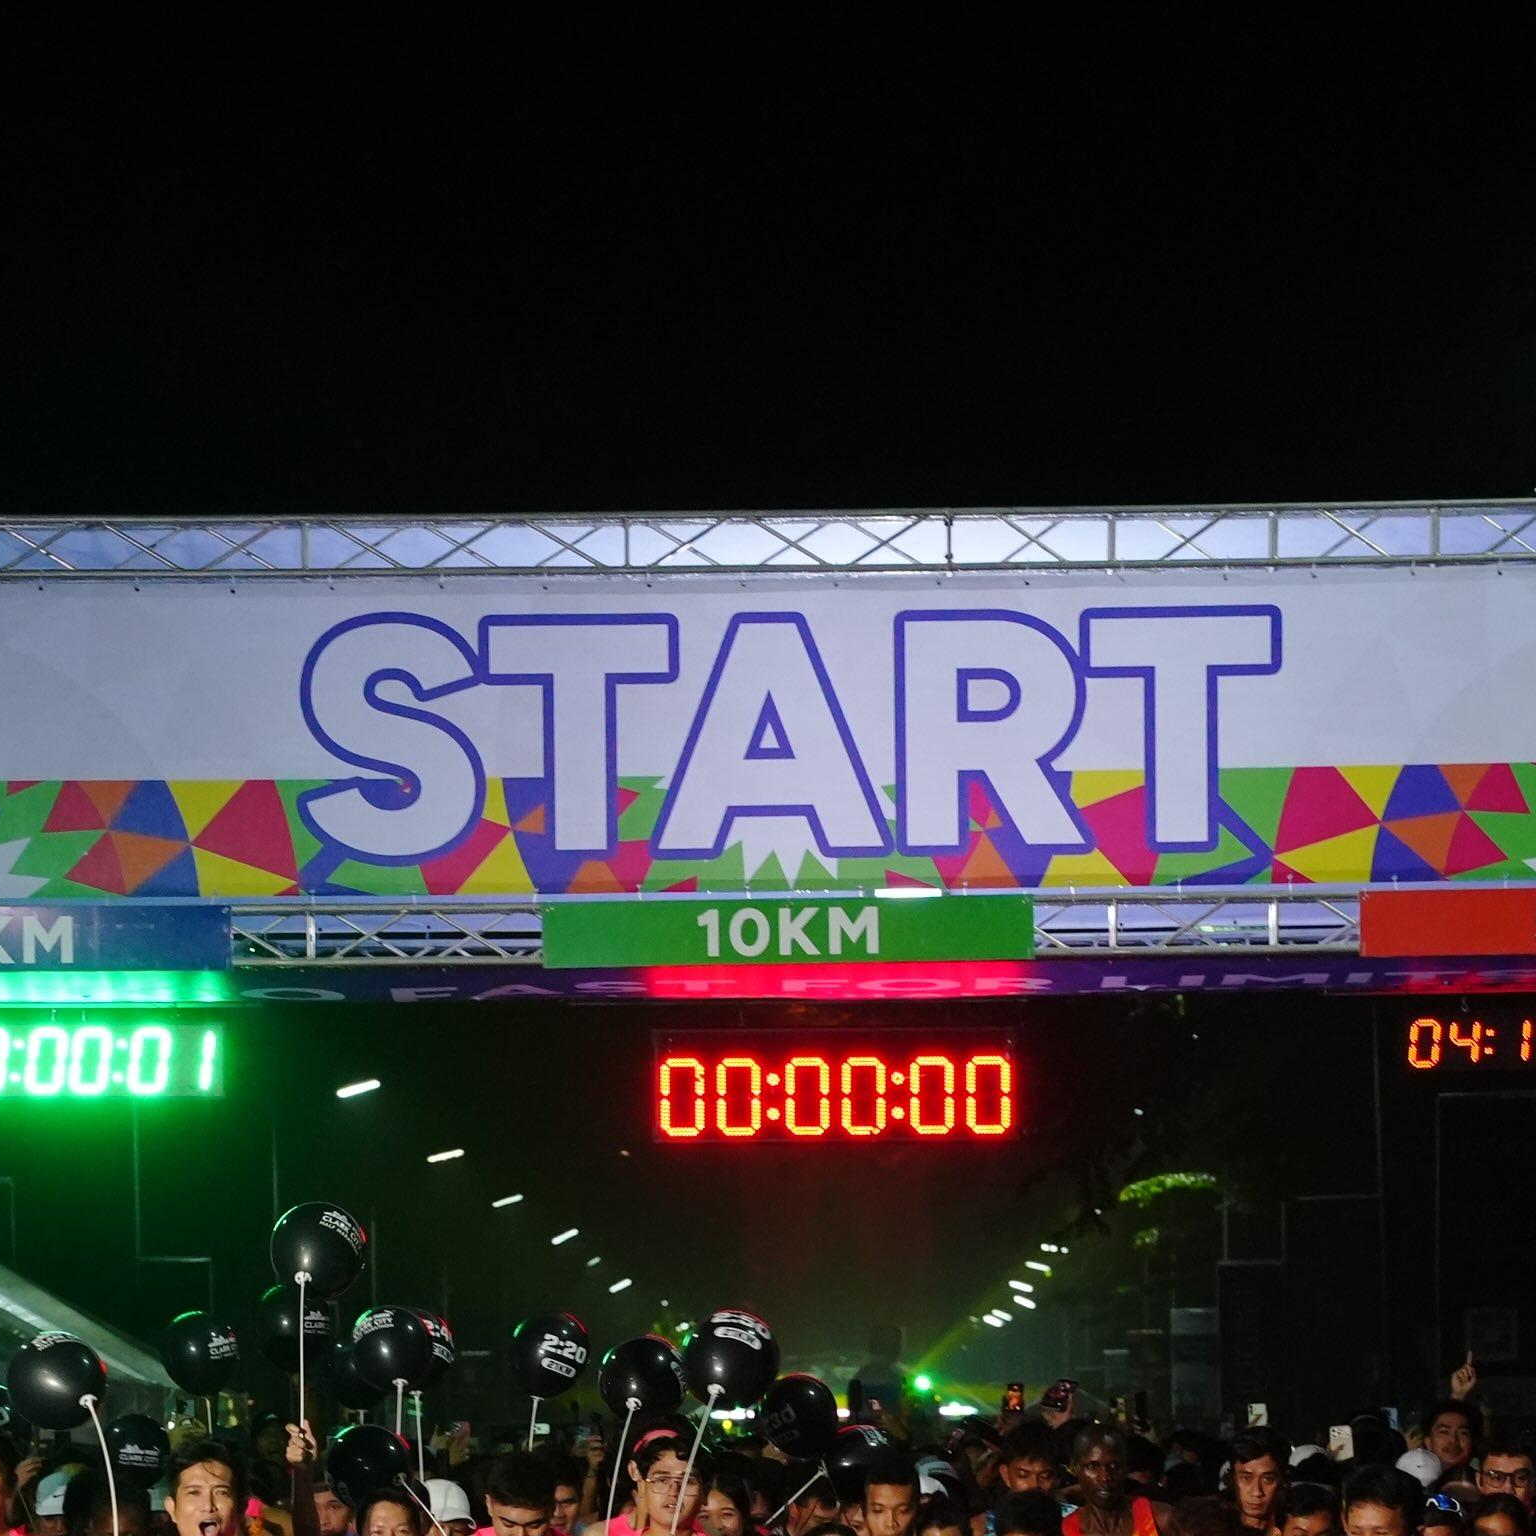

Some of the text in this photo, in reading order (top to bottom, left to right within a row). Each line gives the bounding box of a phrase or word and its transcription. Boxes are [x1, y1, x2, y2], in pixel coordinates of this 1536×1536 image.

[297, 603, 1282, 866] START
[695, 904, 880, 959] 10KM
[659, 1055, 1012, 1138] 00:00:00
[540, 1332, 587, 1365] 2:20
